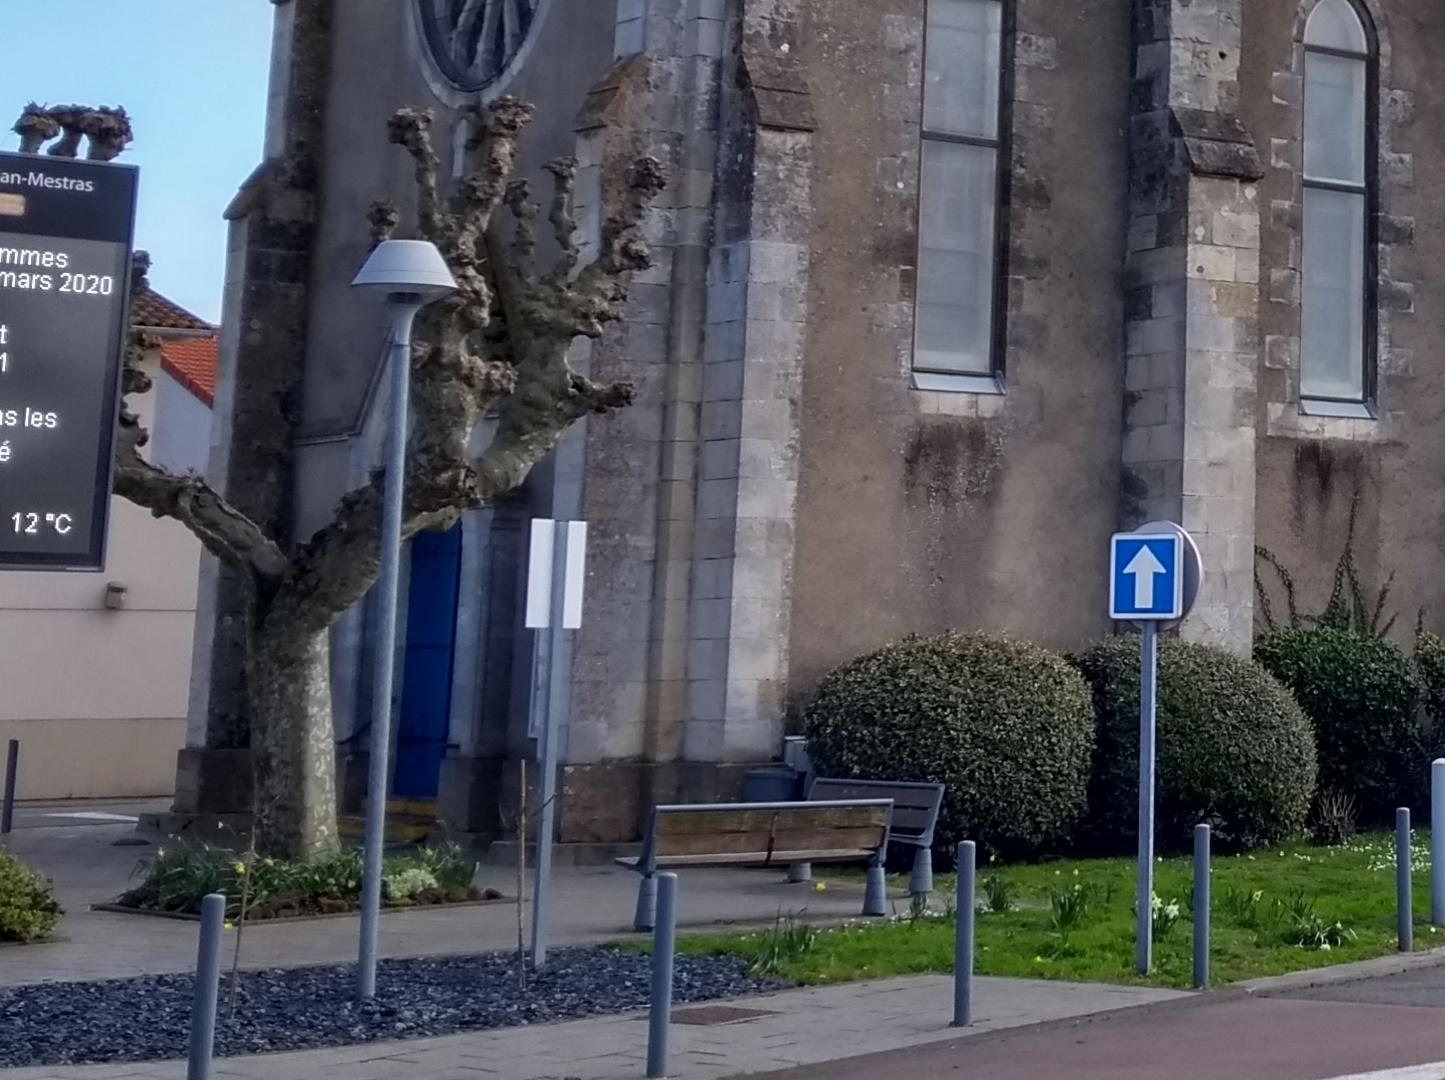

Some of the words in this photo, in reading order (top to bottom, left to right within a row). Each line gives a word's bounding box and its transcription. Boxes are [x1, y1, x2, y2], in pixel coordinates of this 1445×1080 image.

[59, 272, 113, 295] 2020
[25, 407, 58, 428] les
[12, 512, 38, 533] 12
[45, 513, 72, 534] °C
